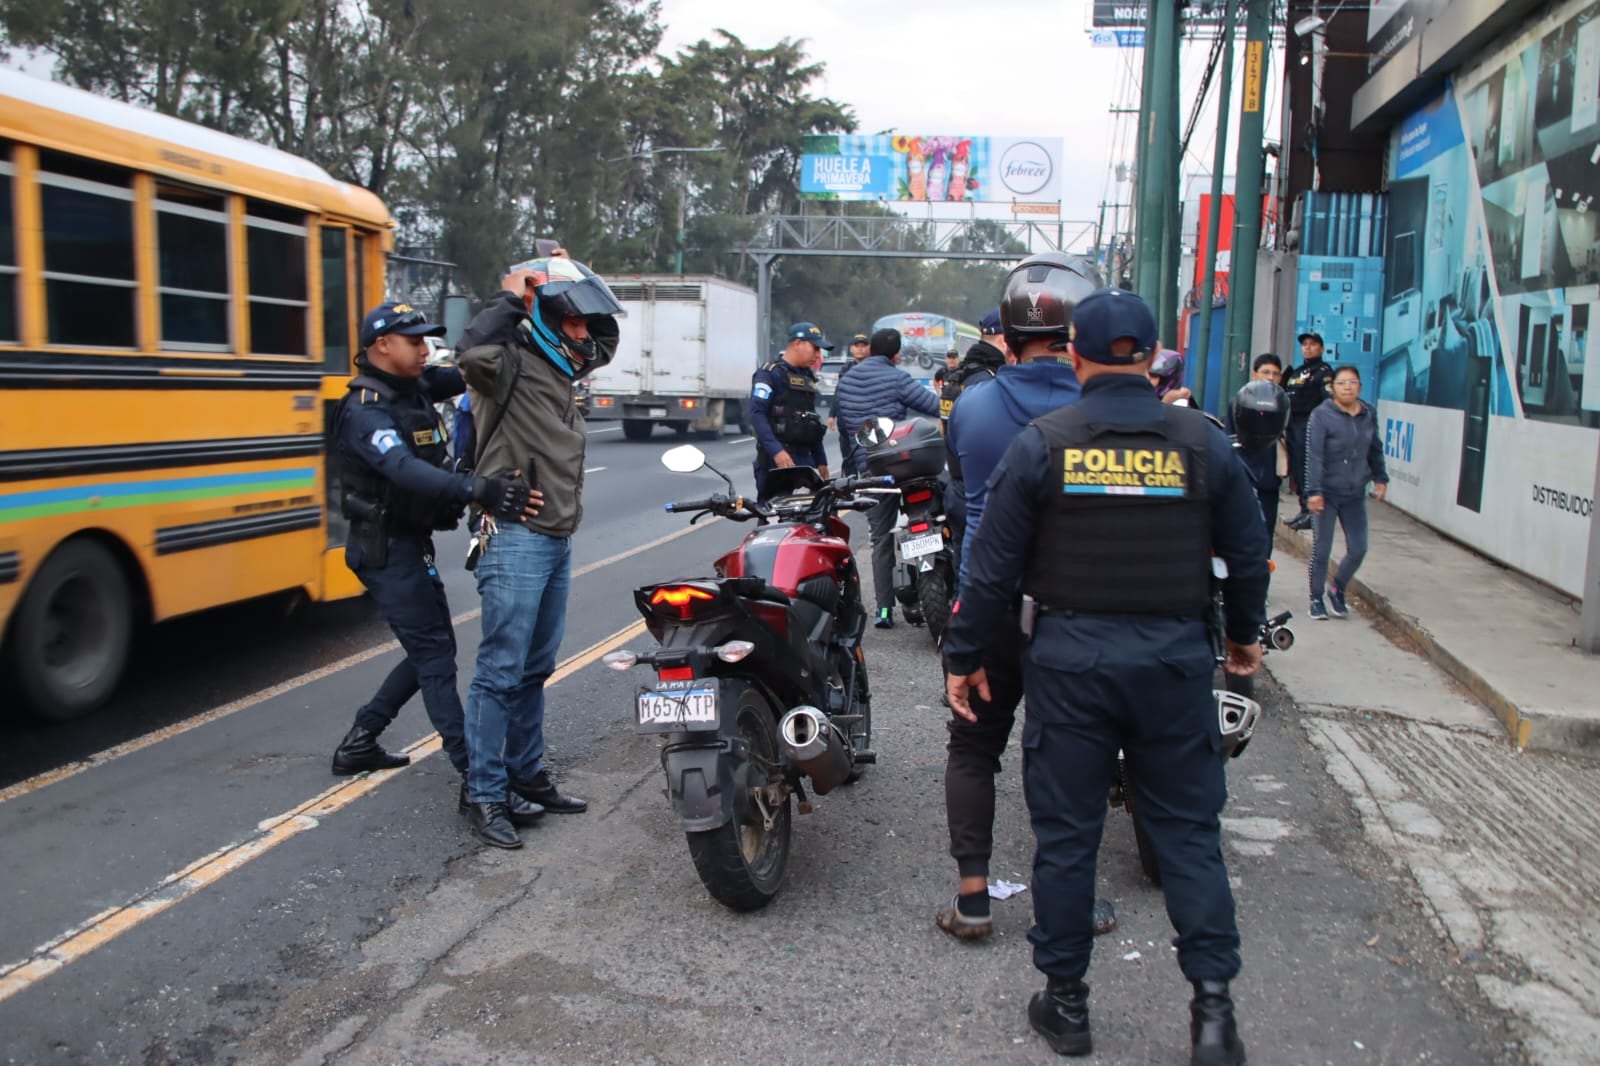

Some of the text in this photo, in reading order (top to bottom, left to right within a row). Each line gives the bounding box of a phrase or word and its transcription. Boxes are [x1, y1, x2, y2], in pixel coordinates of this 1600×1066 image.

[814, 157, 872, 173] HUELE A
[1004, 160, 1047, 178] febreze
[813, 172, 872, 185] PRIMAVERA
[1063, 448, 1186, 474] POLICIA
[1063, 471, 1185, 487] NACIONAL CIVIL
